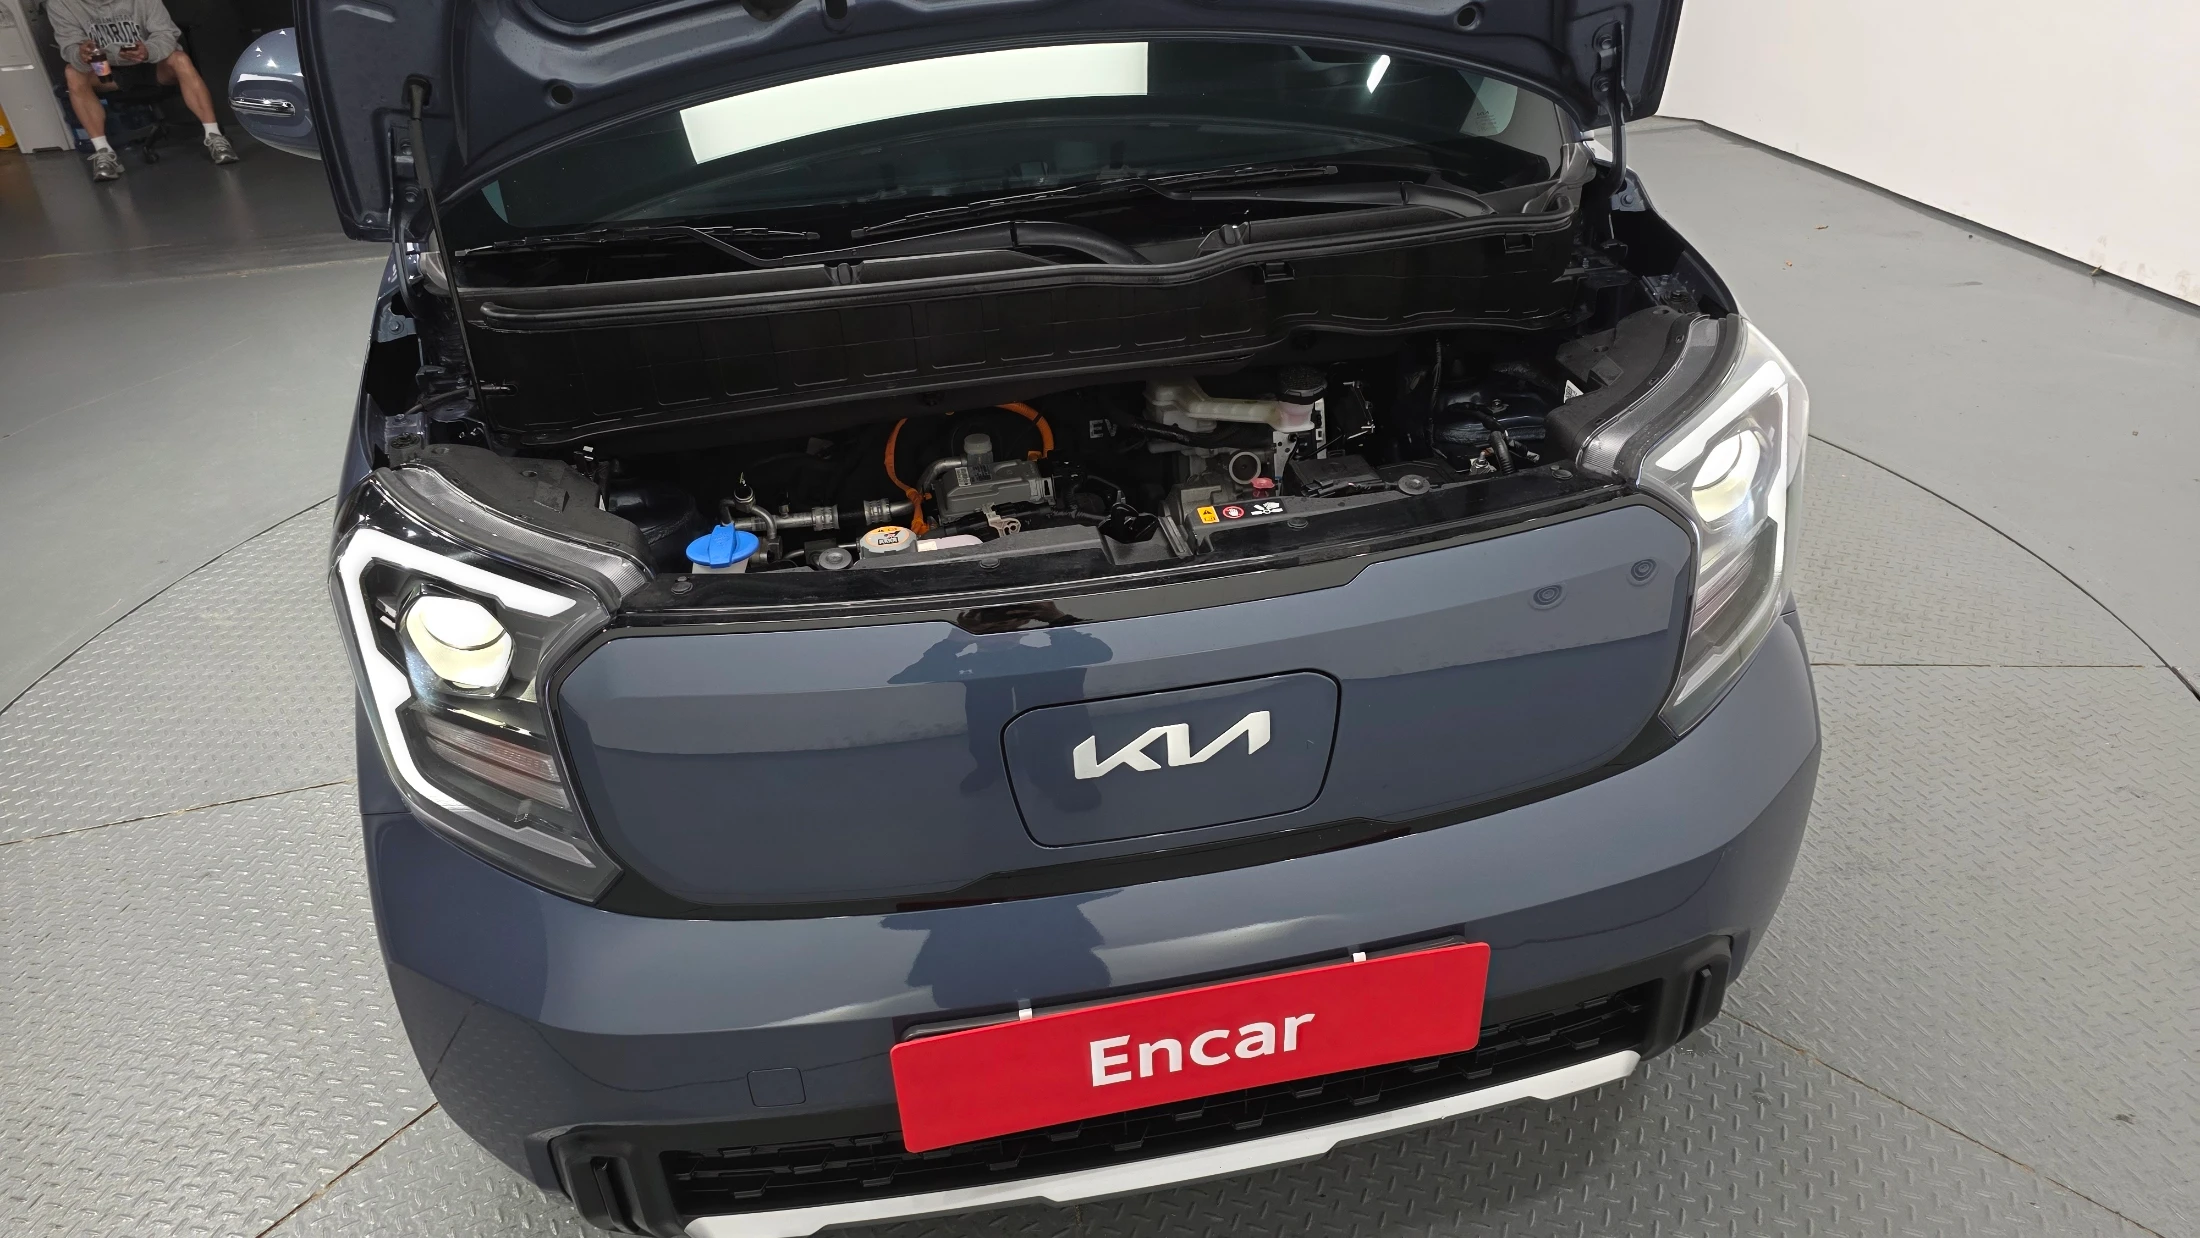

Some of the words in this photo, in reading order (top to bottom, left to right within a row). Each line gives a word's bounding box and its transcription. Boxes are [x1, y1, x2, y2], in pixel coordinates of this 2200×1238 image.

[1089, 418, 1118, 438] EV
[1073, 710, 1271, 780] KIA
[1089, 1013, 1316, 1087] Encar
